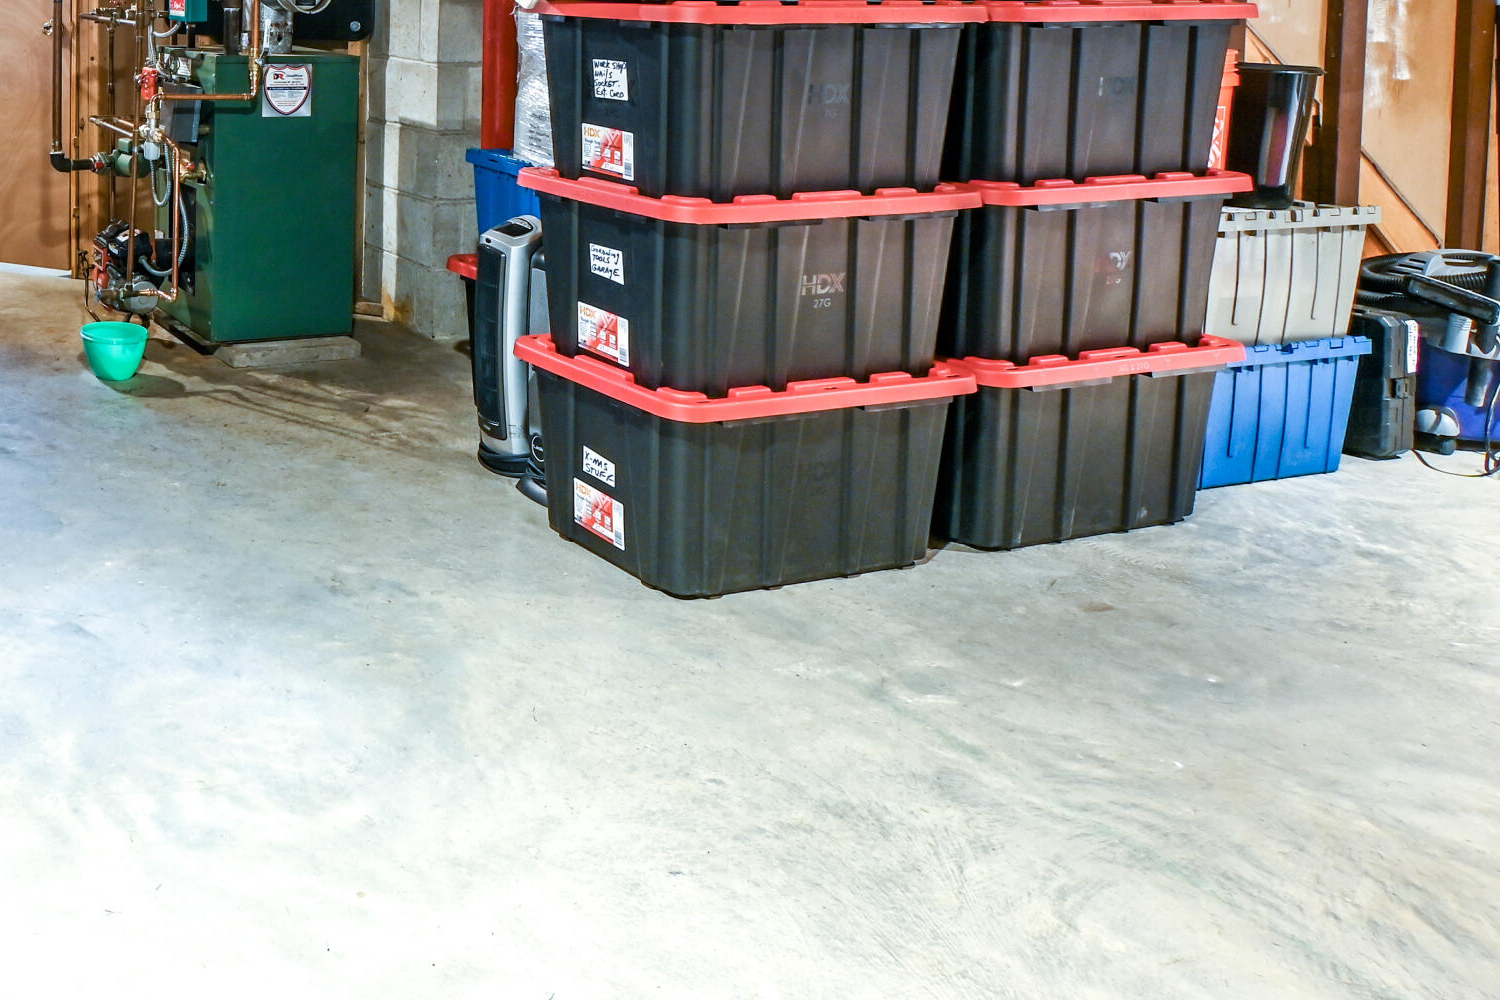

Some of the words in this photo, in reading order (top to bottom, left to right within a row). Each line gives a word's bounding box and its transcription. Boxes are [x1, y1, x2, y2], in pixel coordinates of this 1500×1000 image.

[583, 127, 601, 138] HDX
[801, 272, 846, 296] HDX
[812, 298, 832, 309] 27G
[580, 305, 597, 320] HDX
